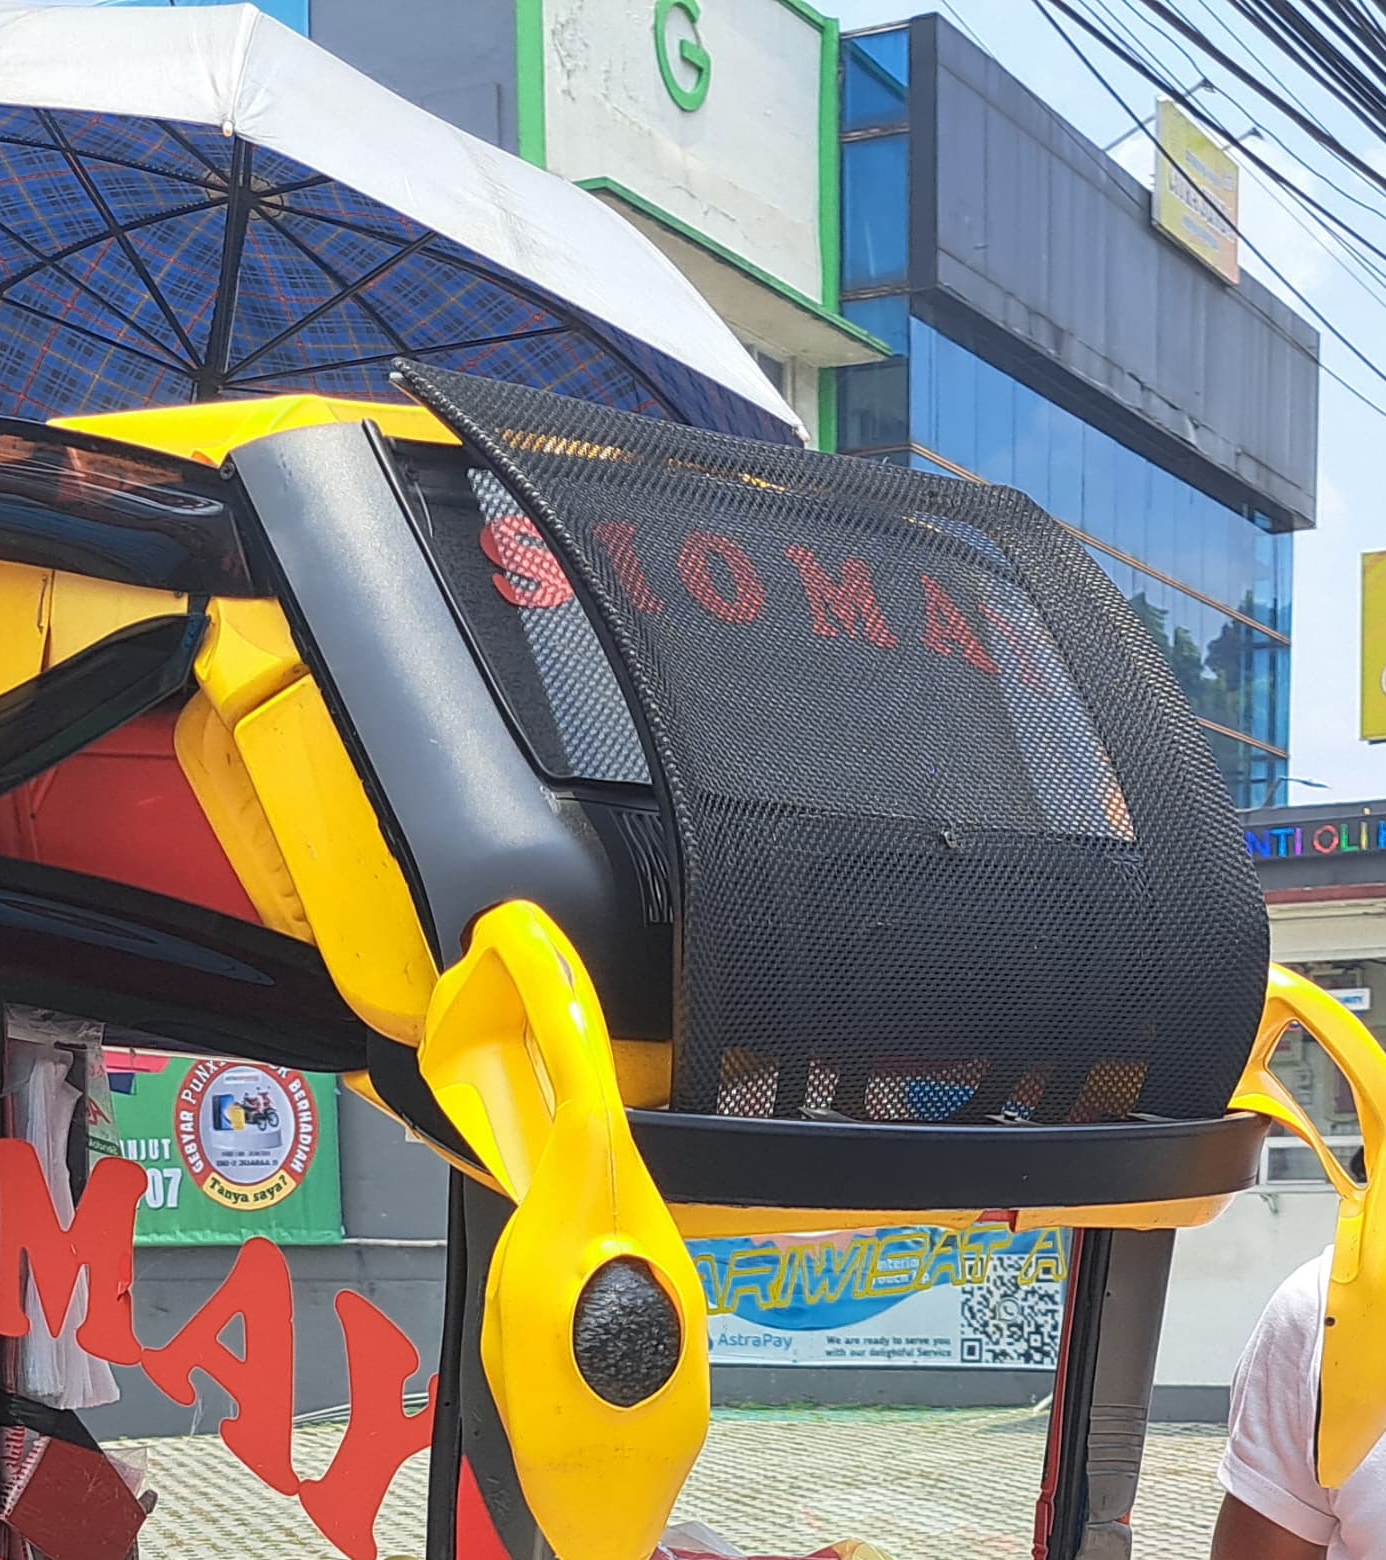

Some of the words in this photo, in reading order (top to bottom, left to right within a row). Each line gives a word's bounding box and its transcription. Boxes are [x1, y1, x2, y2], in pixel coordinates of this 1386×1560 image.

[1313, 821, 1368, 854] OLI
[180, 1110, 204, 1174] GEBYAR
[287, 1076, 315, 1174] BERHADIAH
[139, 1168, 183, 1209] 07
[209, 1176, 249, 1204] Tanya
[252, 1174, 288, 1203] saya?
[717, 1333, 793, 1352] AstraPay
